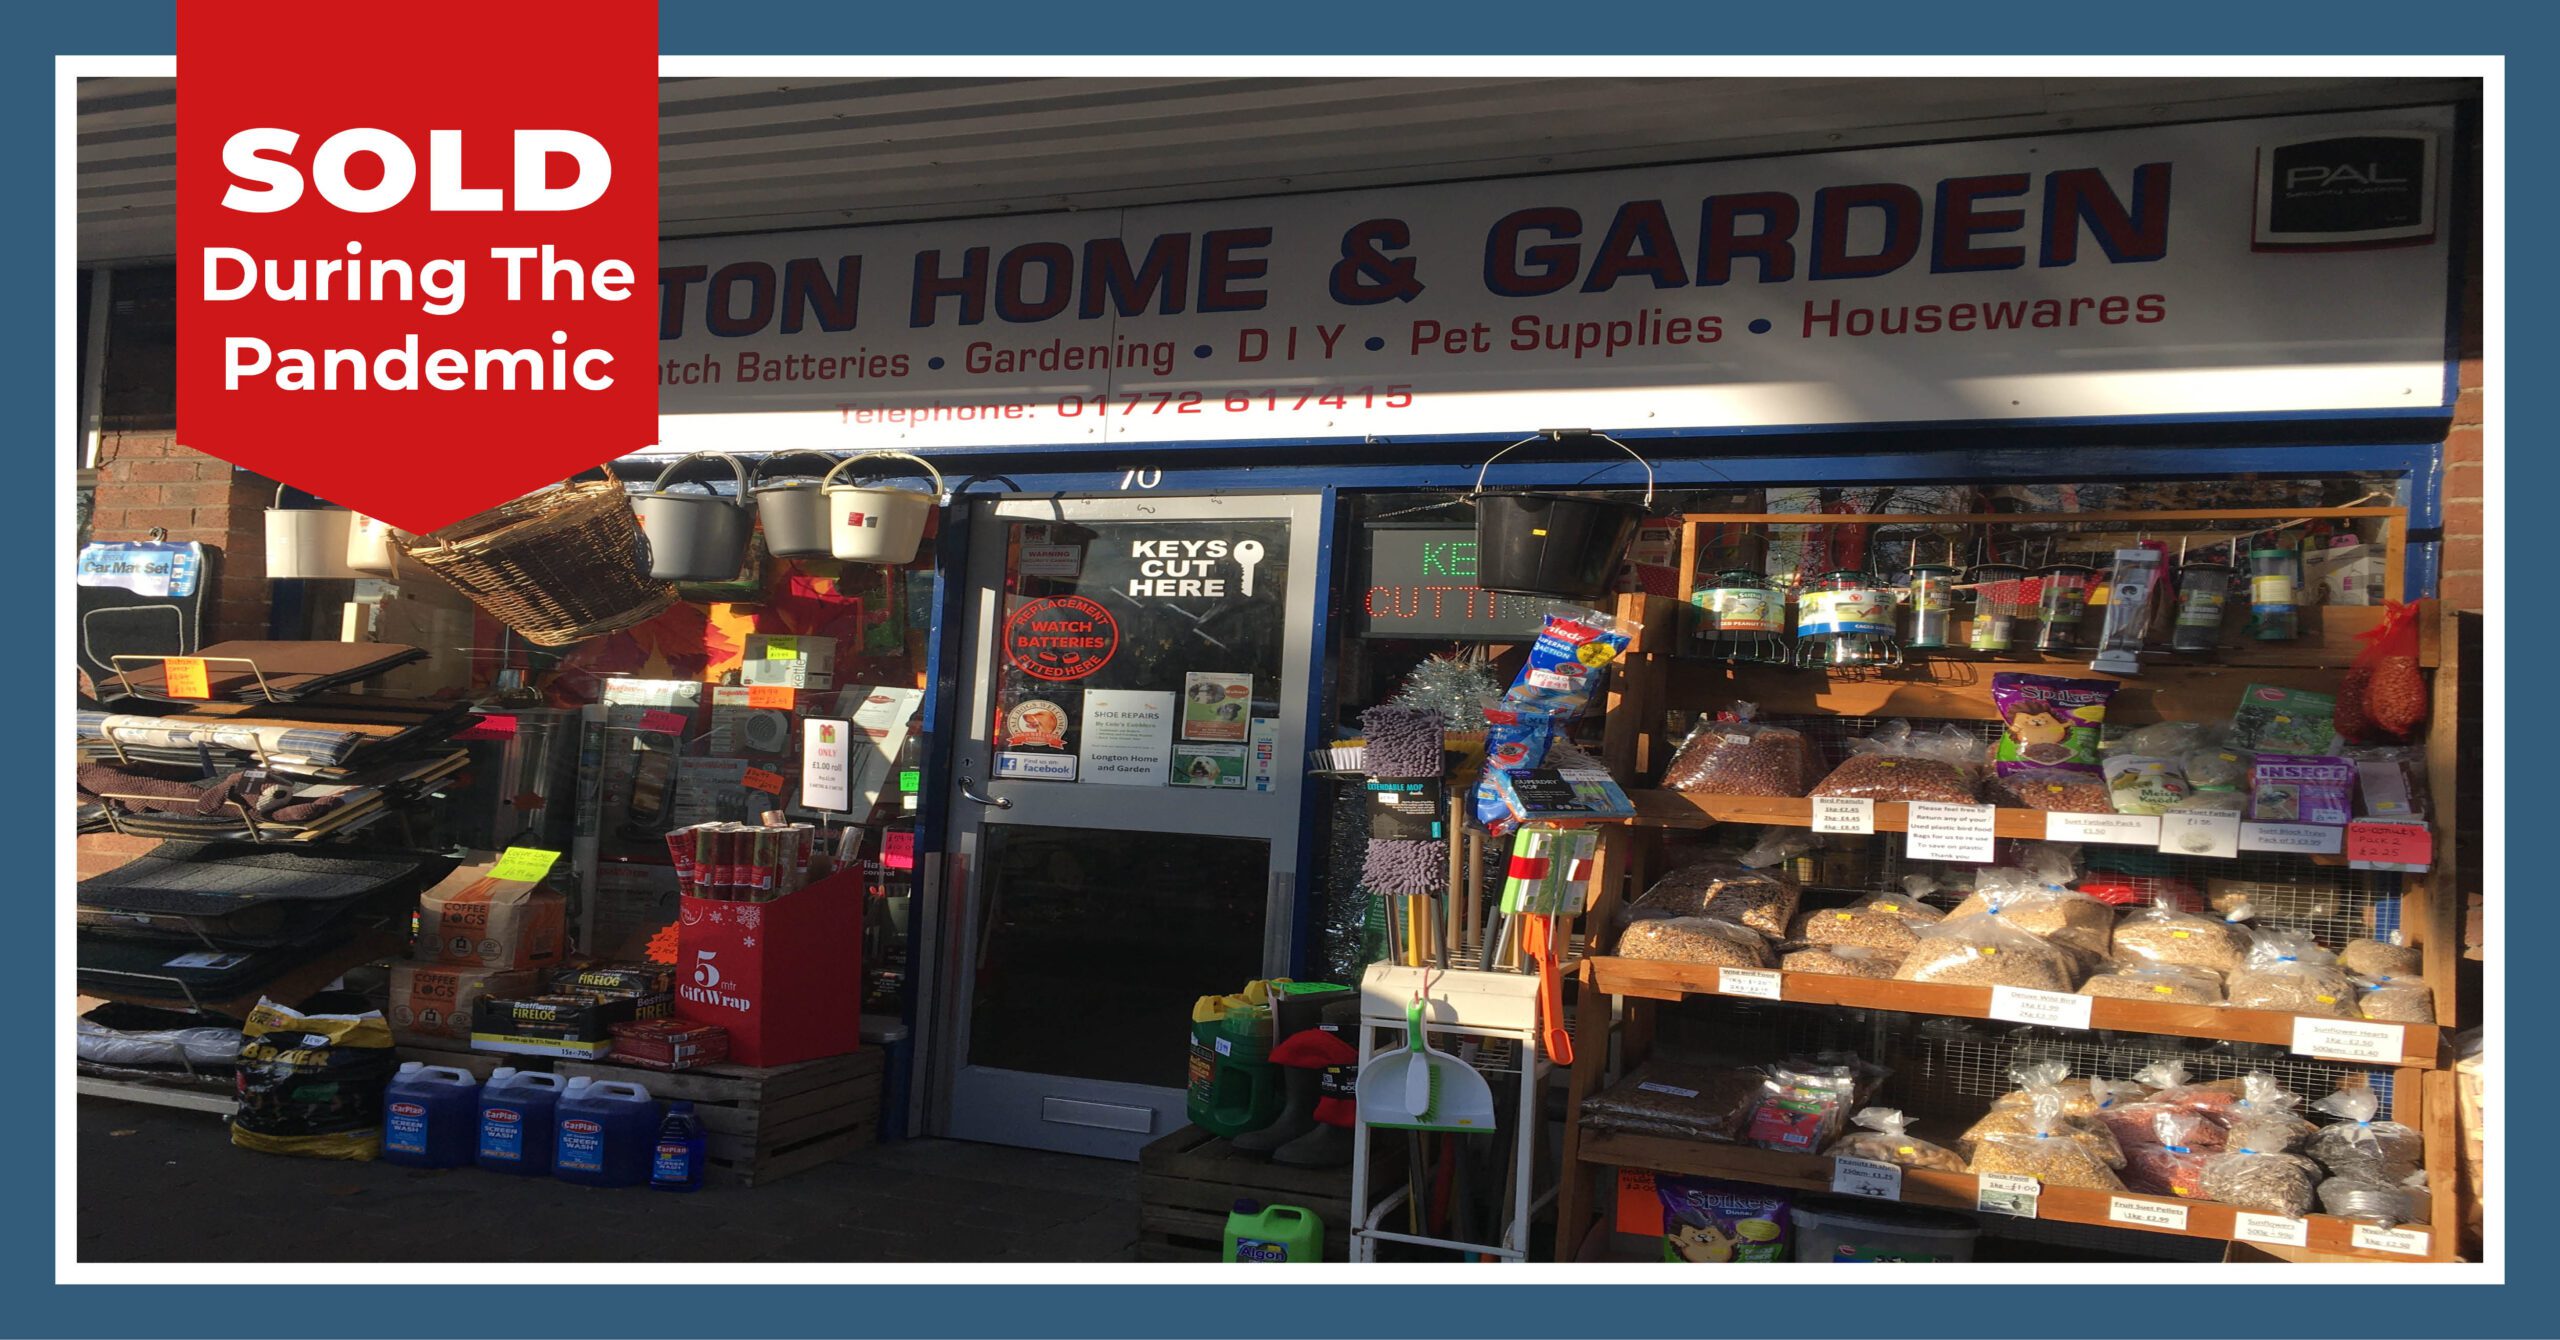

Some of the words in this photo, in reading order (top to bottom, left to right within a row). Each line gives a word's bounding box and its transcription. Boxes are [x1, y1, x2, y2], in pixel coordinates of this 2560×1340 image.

[2286, 162, 2408, 189] PAL
[909, 226, 1273, 328] HOME
[1328, 217, 1426, 307] &
[1483, 161, 2173, 298] GARDEN
[735, 346, 911, 384] Batteries
[964, 334, 1176, 376] Gardening
[1411, 319, 1491, 356] Pet
[1510, 307, 1723, 359] Supplies
[1802, 294, 2167, 339] Housewares
[836, 402, 1036, 429] Telephone:
[1057, 390, 1203, 418] 01772
[1223, 384, 1413, 411] 617415
[1120, 465, 1163, 490] 70
[1028, 550, 1071, 559] WARNING
[1132, 539, 1229, 559] KEYS
[83, 561, 111, 573] Car
[112, 562, 142, 575] Mat
[143, 562, 169, 575] Set
[1140, 559, 1215, 578] CUT
[1128, 579, 1225, 598] HERE
[1016, 598, 1110, 626] REPLACEMENT
[1031, 620, 1092, 633] WATCH
[1733, 620, 1760, 629] PEANUT
[1017, 636, 1105, 649] BATTERIES
[1017, 653, 1063, 677] FITTED
[1064, 654, 1102, 676] HERE
[2021, 685, 2107, 703] Spike's
[1094, 711, 1119, 719] SHOE
[1121, 712, 1160, 720] REPAIRS
[817, 748, 837, 757] ONLY
[1091, 753, 1129, 762] Longton
[1130, 755, 1159, 763] Home
[811, 761, 831, 770] £1.00
[831, 763, 844, 772] roll
[1023, 764, 1070, 774] facebook
[1097, 764, 1115, 772] and
[1116, 765, 1151, 774] Garden
[2258, 764, 2347, 782] INSECT
[1367, 783, 1405, 792] EXTENDABLE
[1406, 783, 1424, 792] MOP
[2084, 819, 2114, 827] Fatballs
[2116, 820, 2134, 828] Pack
[2391, 837, 2401, 846] 2
[2359, 848, 2400, 857] £2.25
[444, 902, 486, 914] COFFEE
[441, 911, 486, 926] LOGS
[693, 949, 720, 988] 5
[414, 973, 457, 986] COFFEE
[578, 972, 621, 987] FIRELOG
[413, 981, 455, 998] LOGS
[720, 981, 737, 992] mtr
[2010, 991, 2039, 1000] Deluxe
[2040, 994, 2057, 1003] Wild
[2058, 996, 2077, 1005] Bird
[513, 1001, 558, 1011] Bestflame
[512, 1008, 557, 1021] FIRELOG
[2313, 1025, 2358, 1036] Sunflower
[2359, 1029, 2389, 1039] Hearts
[392, 1103, 424, 1114] CarPlan
[485, 1109, 518, 1121] CarPlan
[390, 1118, 423, 1129] SCREEN
[393, 1124, 419, 1133] WASH
[484, 1124, 518, 1135] SCREEN
[563, 1121, 599, 1132] CarPlan
[487, 1131, 514, 1140] WASH
[563, 1136, 599, 1147] SCREEN
[565, 1142, 594, 1151] WASH
[656, 1144, 687, 1154] CarPlan
[1838, 1157, 1868, 1168] Peanuts
[1873, 1170, 1894, 1180] £1.25
[1988, 1172, 2007, 1180] Duck
[2009, 1174, 2029, 1183] Food
[1686, 1190, 1778, 1212] Spike's
[1725, 1209, 1753, 1217] Dinner
[2114, 1201, 2134, 1210] Fruit
[2135, 1203, 2153, 1212] Suet
[2154, 1205, 2184, 1216] Pellets
[2146, 1214, 2170, 1224] £2.99
[2247, 1217, 2295, 1230] Sunflowers
[1239, 1246, 1287, 1262] Algon
